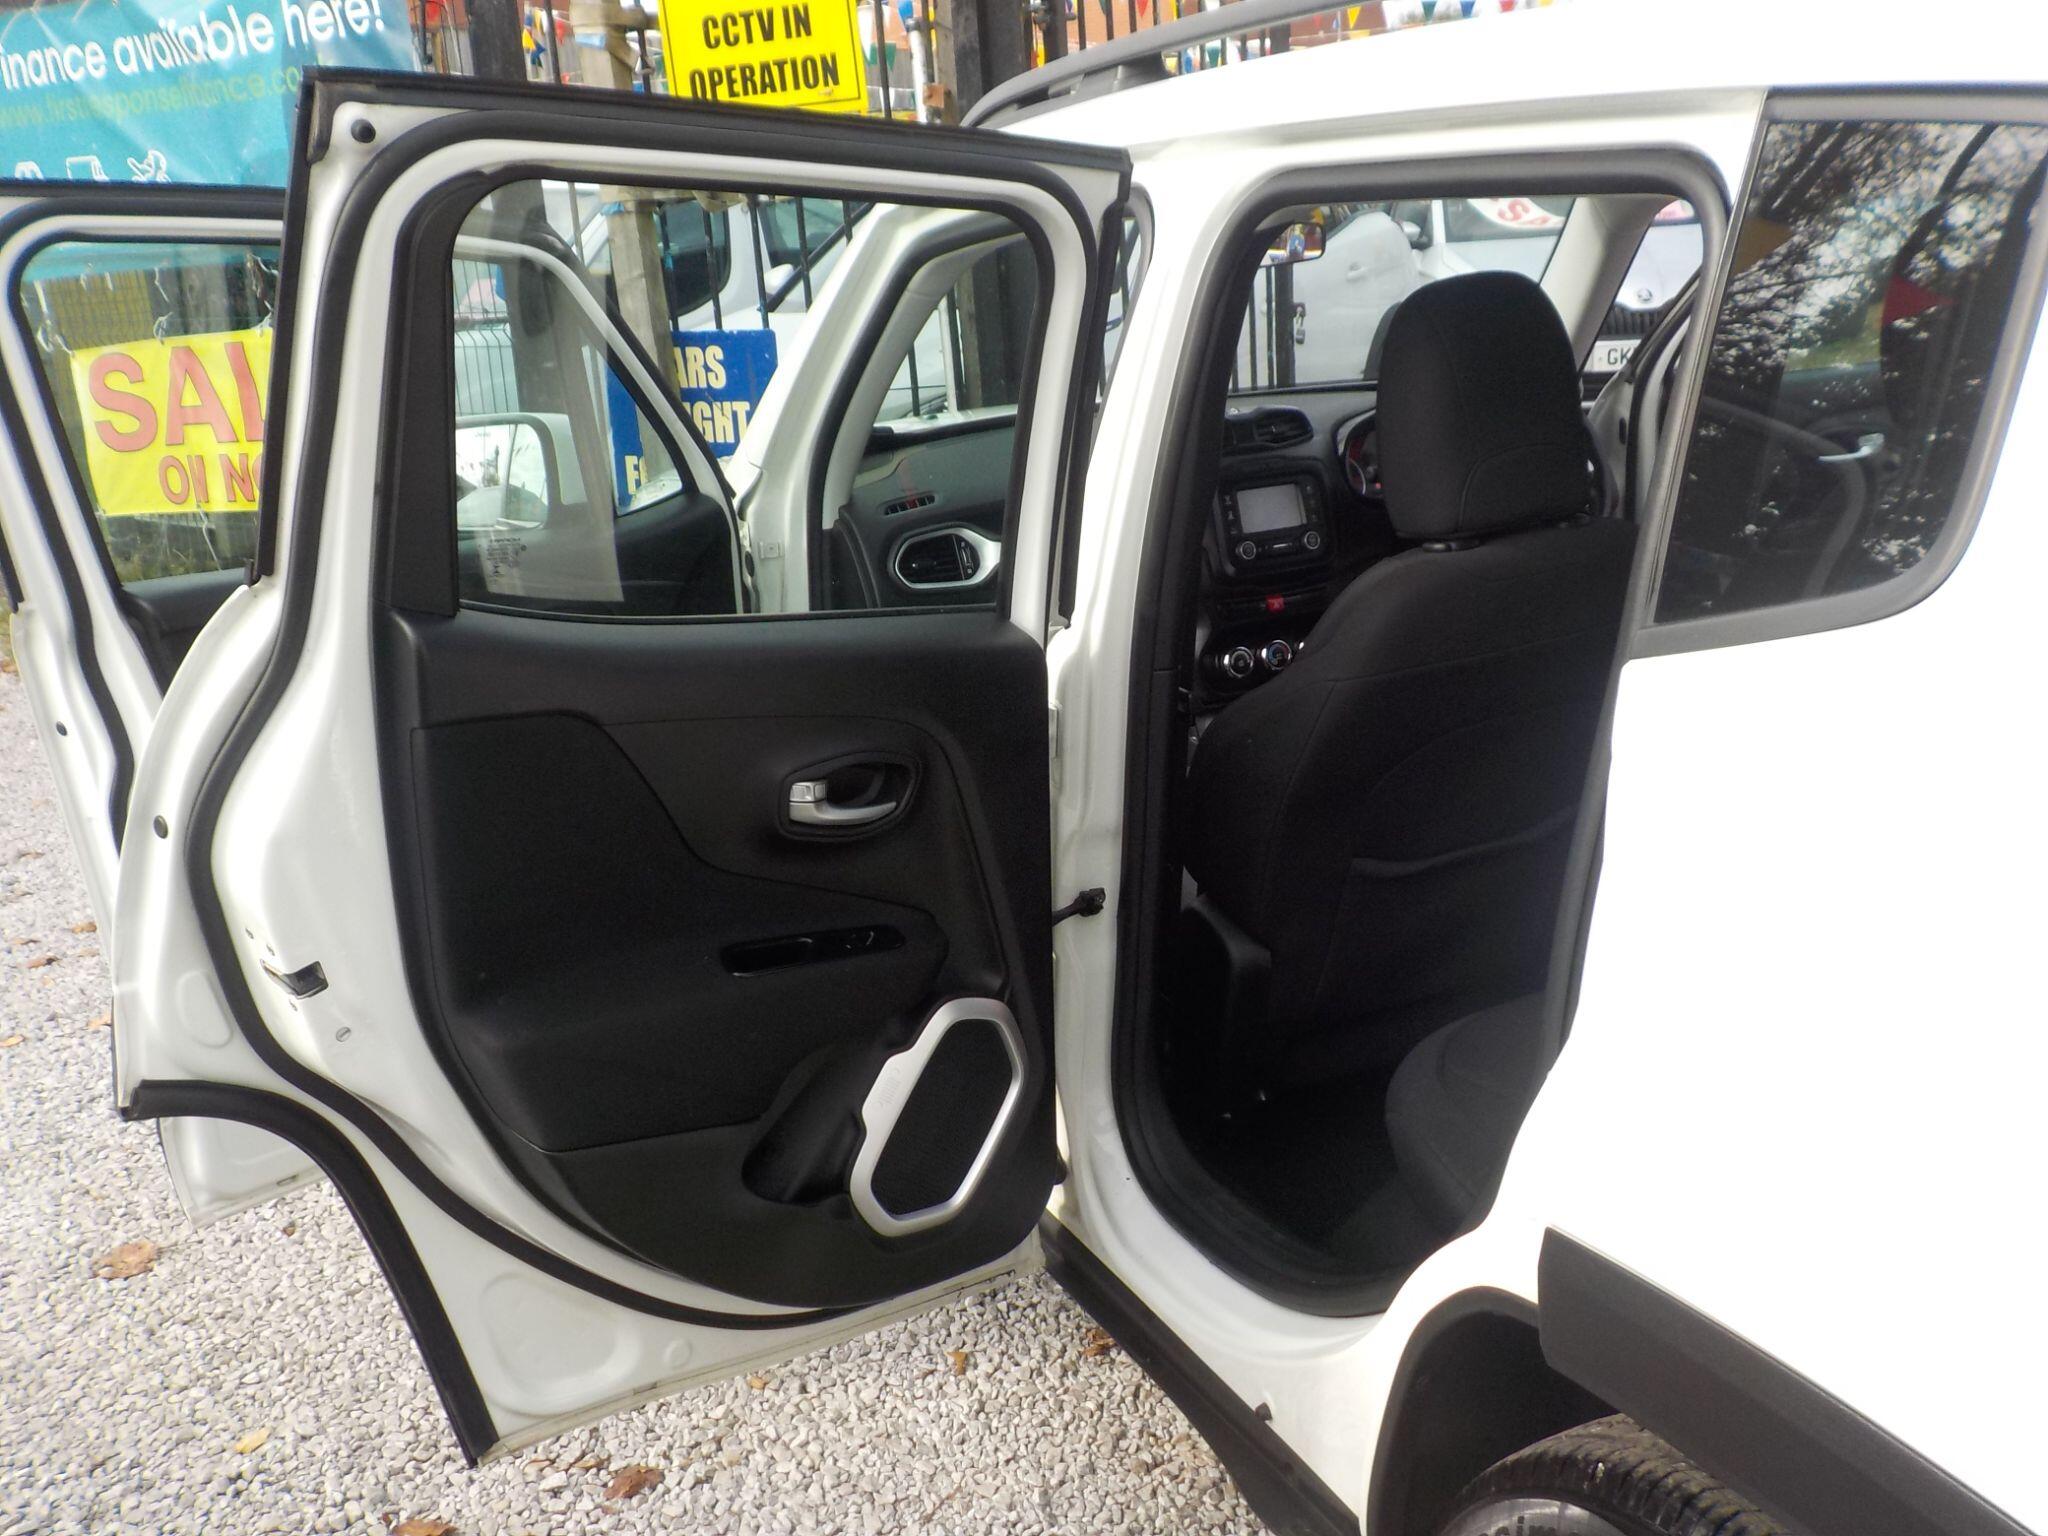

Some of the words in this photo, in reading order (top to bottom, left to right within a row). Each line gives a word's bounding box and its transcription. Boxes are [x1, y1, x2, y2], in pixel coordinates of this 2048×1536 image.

[0, 41, 107, 90] inance
[113, 4, 274, 73] available
[282, 0, 386, 48] here!
[702, 6, 775, 49] CCTV
[782, 2, 812, 38] IN
[689, 52, 840, 102] OPERATION
[682, 401, 751, 443] GHT
